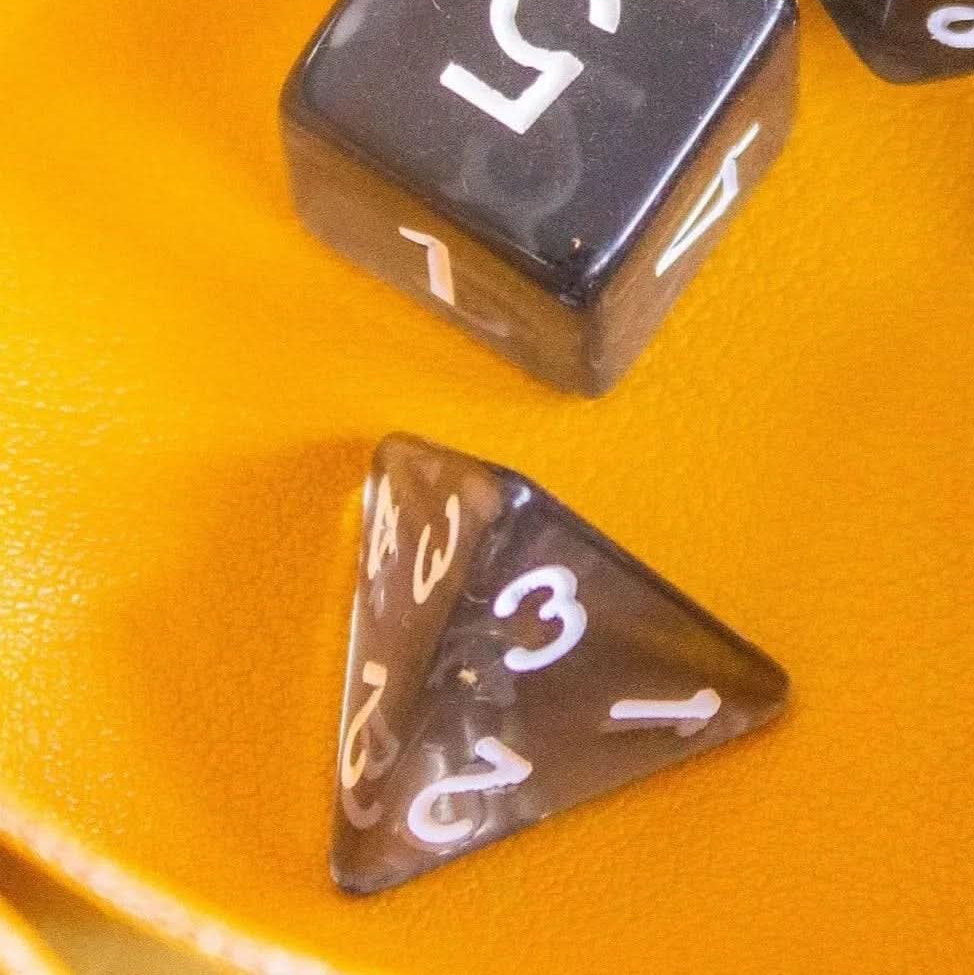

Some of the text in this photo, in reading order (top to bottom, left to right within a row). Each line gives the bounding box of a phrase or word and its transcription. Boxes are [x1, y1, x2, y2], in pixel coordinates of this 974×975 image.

[413, 493, 460, 605] 3
[493, 564, 587, 673] 3
[609, 688, 721, 720] 1
[407, 736, 532, 843] 2
